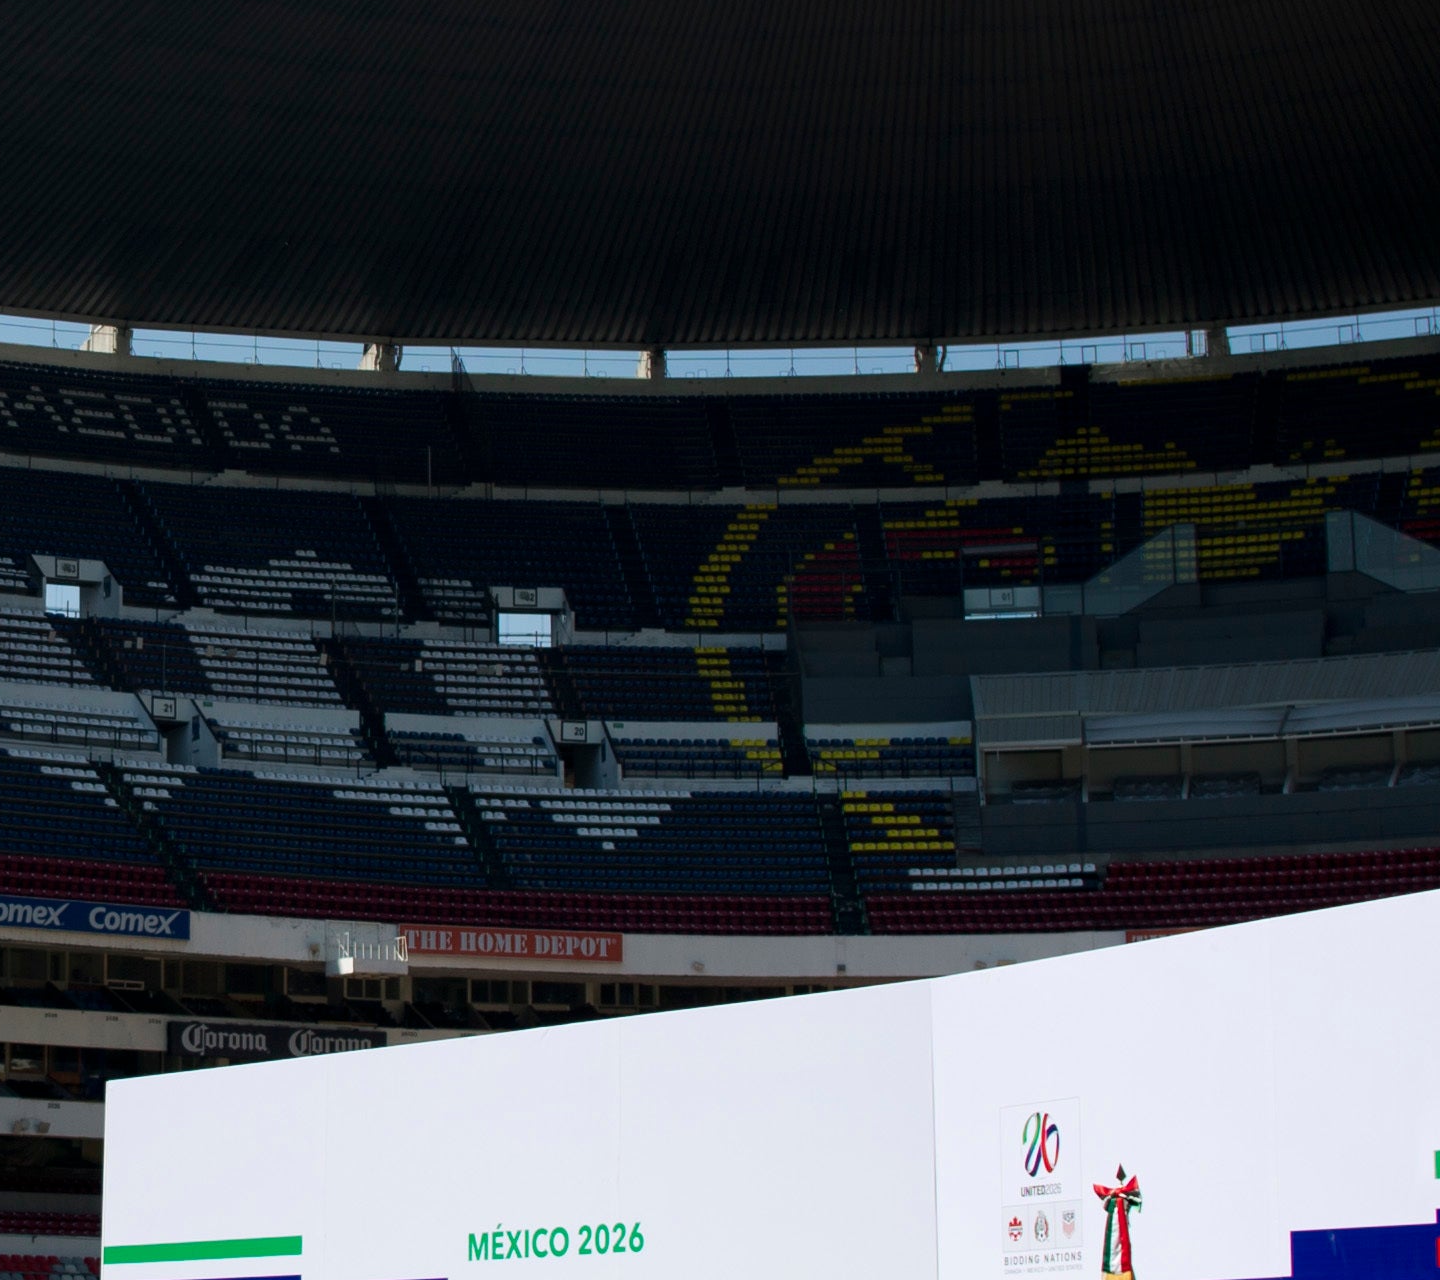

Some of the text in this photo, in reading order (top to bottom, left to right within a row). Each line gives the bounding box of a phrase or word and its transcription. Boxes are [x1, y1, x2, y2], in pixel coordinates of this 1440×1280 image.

[163, 704, 173, 713] 21
[574, 727, 584, 736] 20
[87, 905, 182, 935] Comex
[405, 928, 612, 960] THE HOME DEPOT
[180, 1022, 269, 1056] Corona
[288, 1028, 372, 1055] Corona
[1020, 1182, 1062, 1198] UNITED2026
[467, 1222, 645, 1262] MÉXICO 2026
[1004, 1251, 1082, 1266] BIDDING NATIONS
